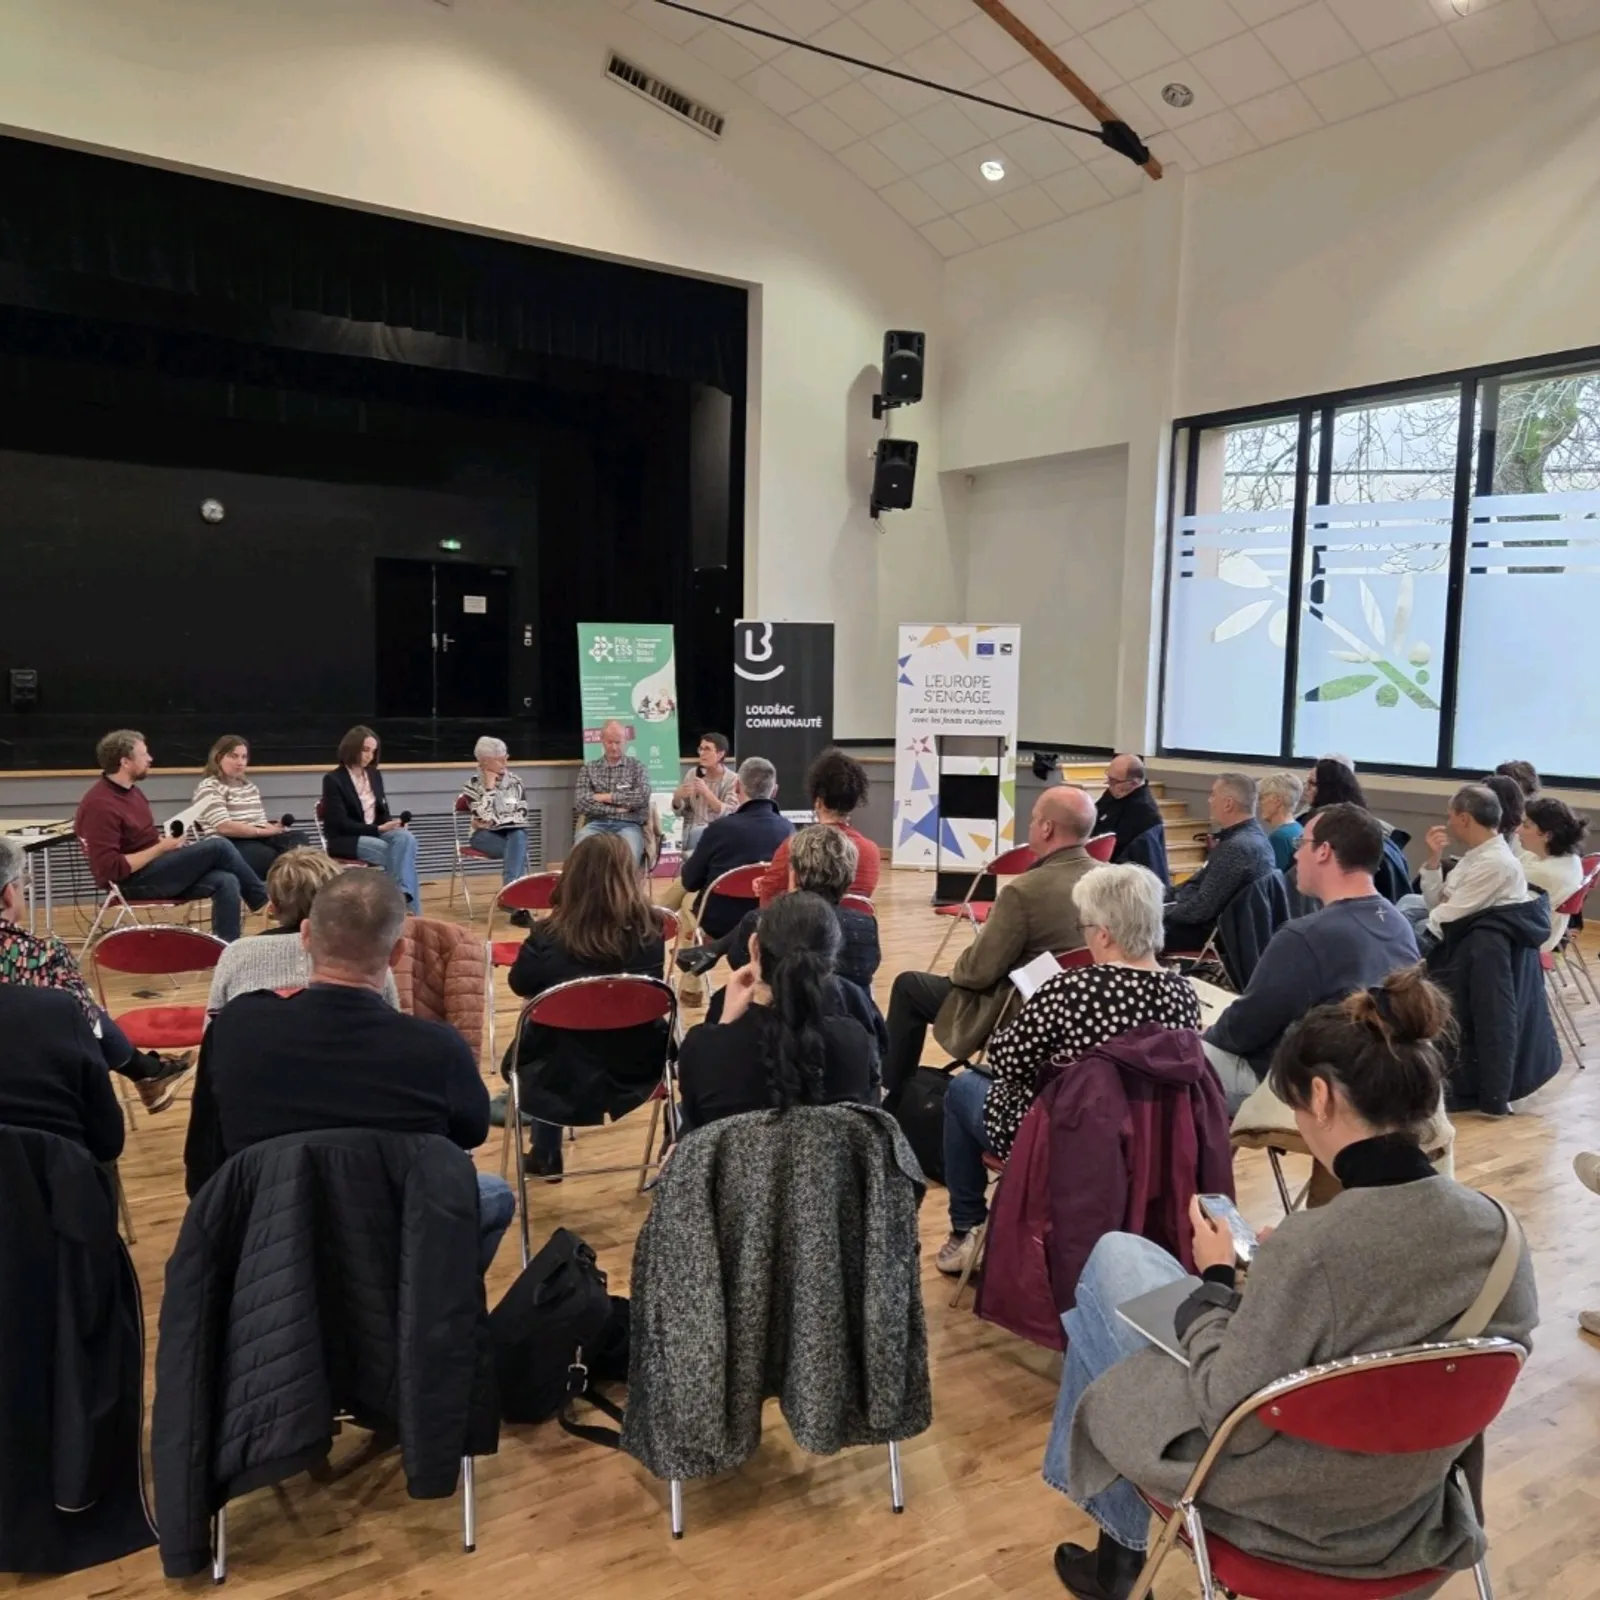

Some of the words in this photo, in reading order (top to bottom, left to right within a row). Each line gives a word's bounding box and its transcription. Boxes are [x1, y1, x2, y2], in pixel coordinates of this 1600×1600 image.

[924, 675, 991, 689] L'EUROPE
[924, 690, 991, 704] S'ENGAGE
[745, 702, 795, 715] LOUDÉAC
[745, 716, 823, 728] COMMUNAUTÉ
